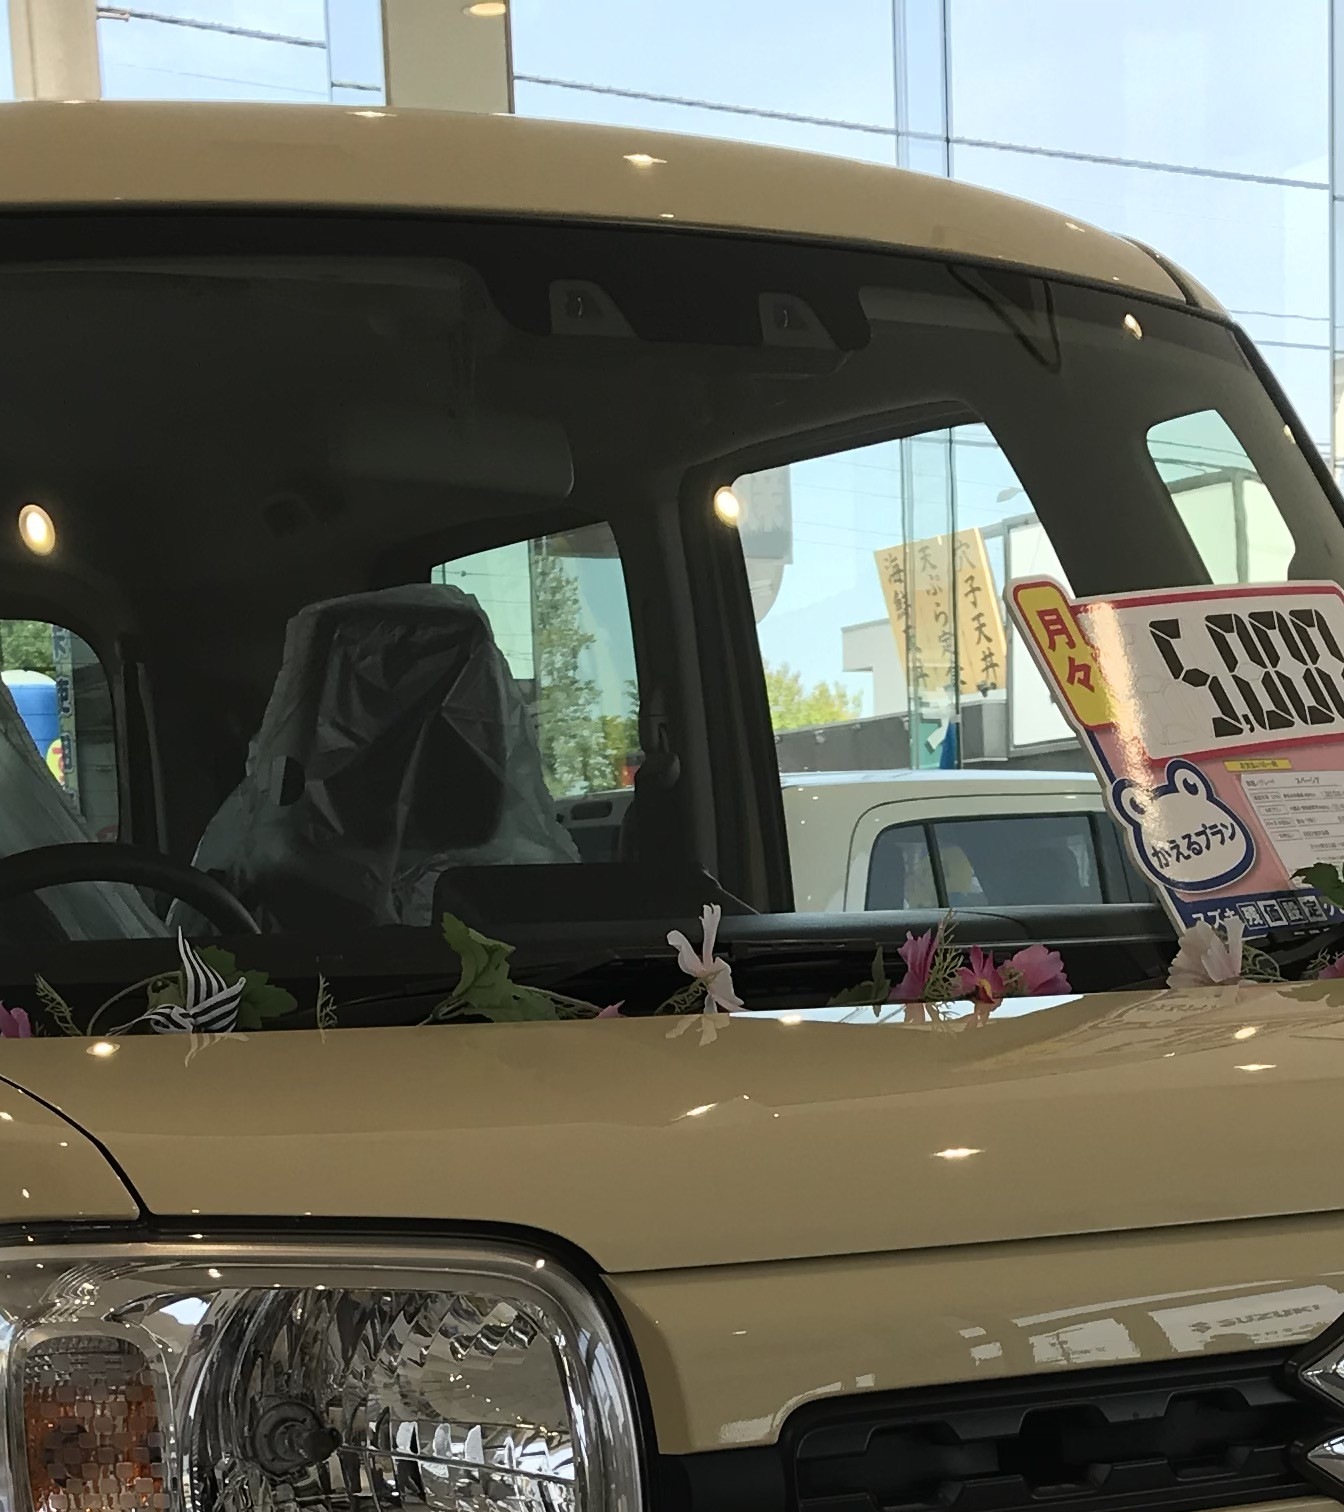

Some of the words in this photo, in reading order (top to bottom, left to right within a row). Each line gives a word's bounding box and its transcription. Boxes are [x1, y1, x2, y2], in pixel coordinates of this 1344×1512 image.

[1036, 608, 1096, 694] 月々
[1151, 821, 1237, 870] かえるプラン
